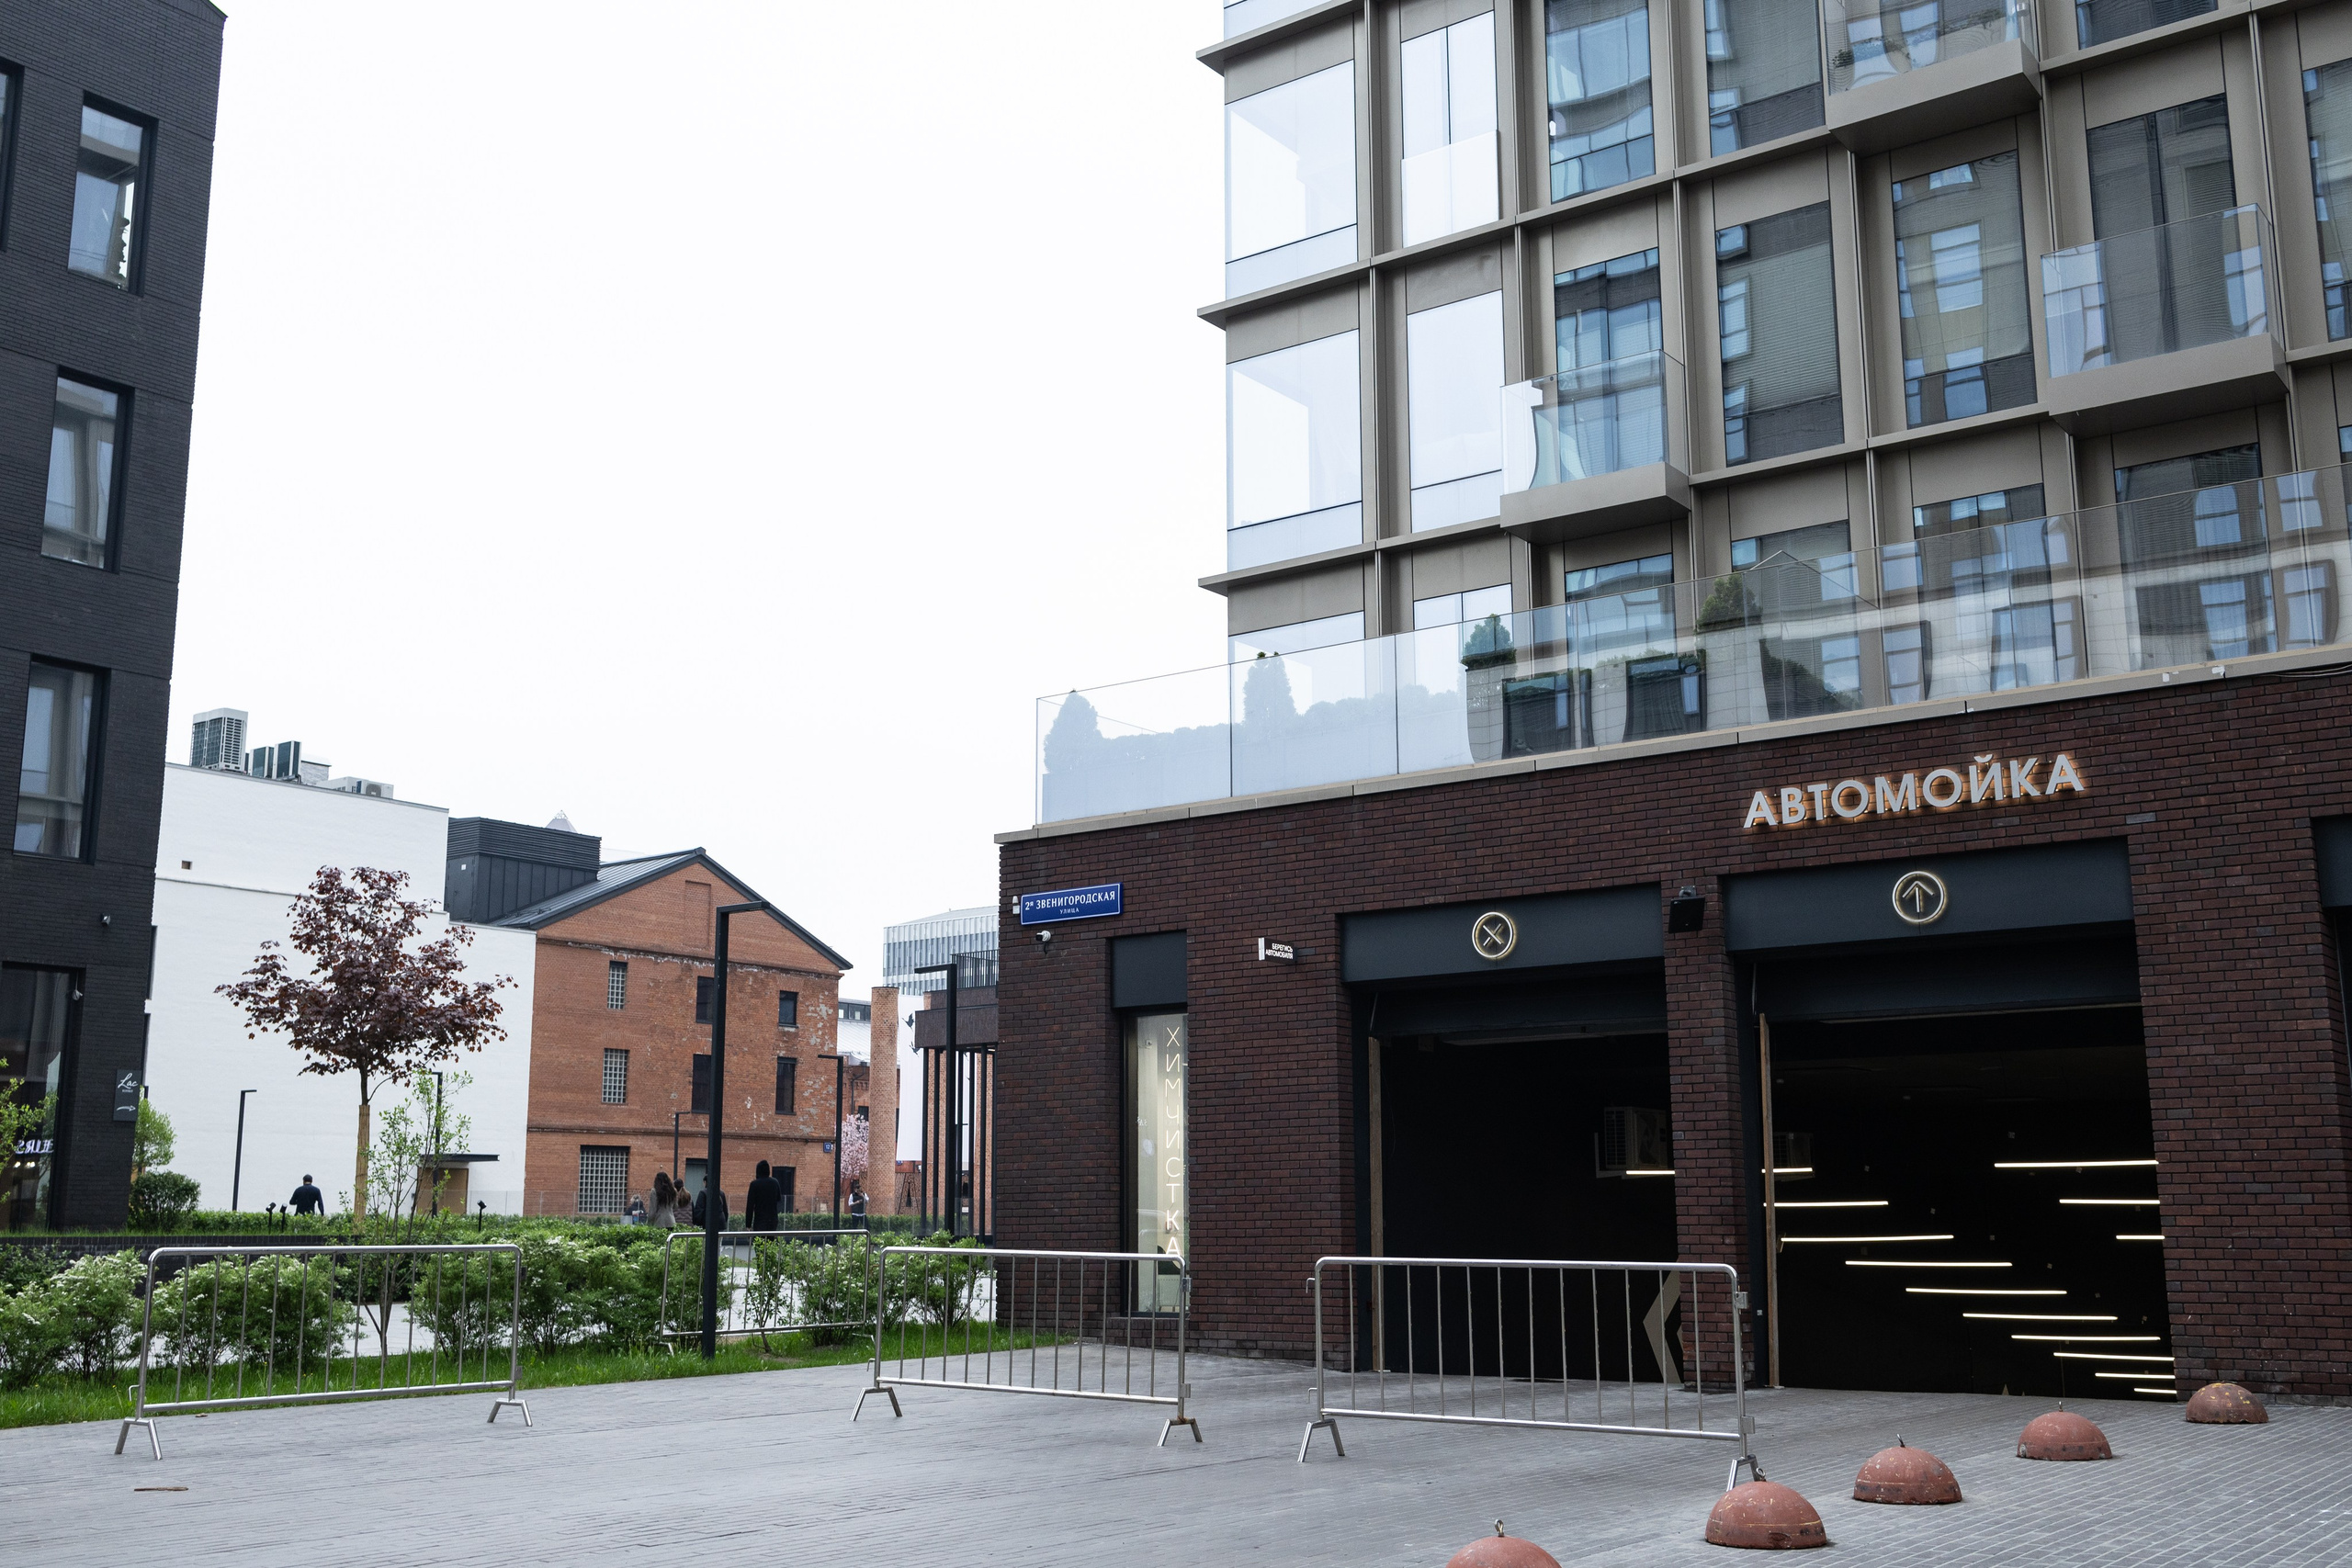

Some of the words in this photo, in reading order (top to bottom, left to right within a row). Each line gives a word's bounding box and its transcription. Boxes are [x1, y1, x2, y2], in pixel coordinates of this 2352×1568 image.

[1743, 753, 2086, 829] АВТОМОЙКА
[1035, 890, 1115, 910] ЗВЕНИГОРОДСКАЯ
[118, 1072, 138, 1089] Lac
[1165, 1026, 1181, 1256] ХИМЧИСТКА
